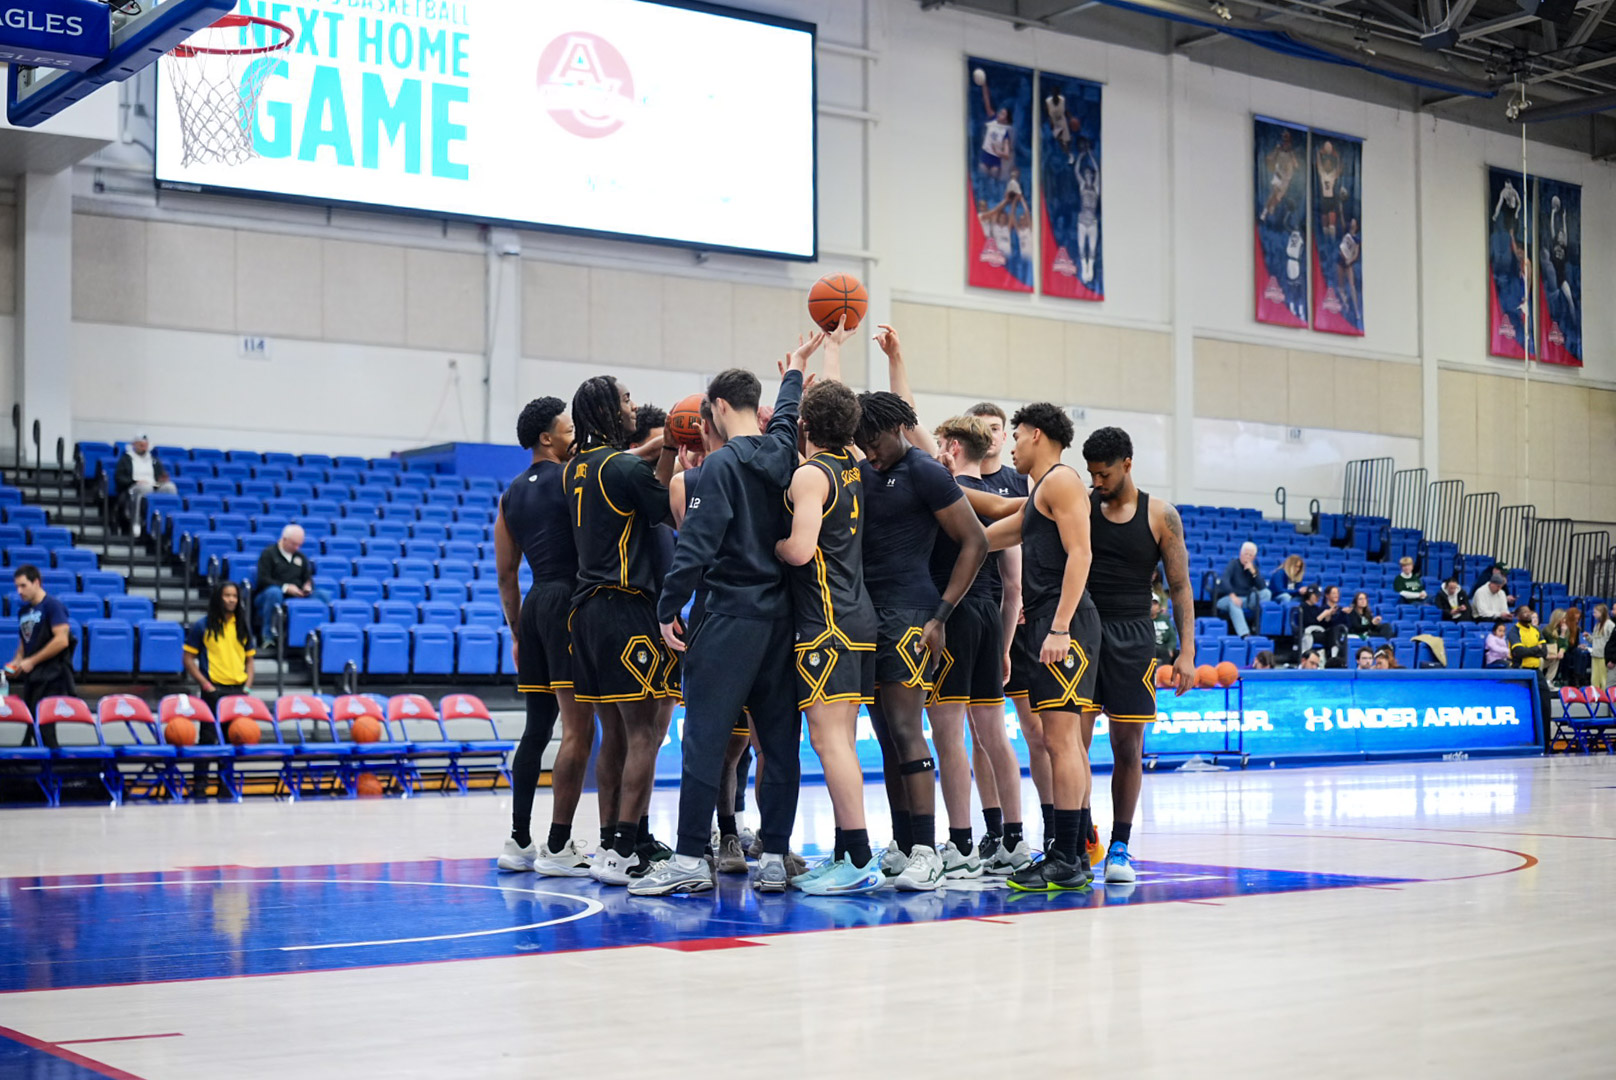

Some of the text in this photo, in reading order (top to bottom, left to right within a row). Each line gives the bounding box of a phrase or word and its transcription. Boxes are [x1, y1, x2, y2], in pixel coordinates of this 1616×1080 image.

[0, 8, 83, 36] GLES
[238, 0, 469, 77] NEXT HOME
[239, 56, 469, 180] GAME
[574, 486, 583, 527] 7
[689, 496, 701, 509] 12
[1336, 707, 1418, 729] UNDER
